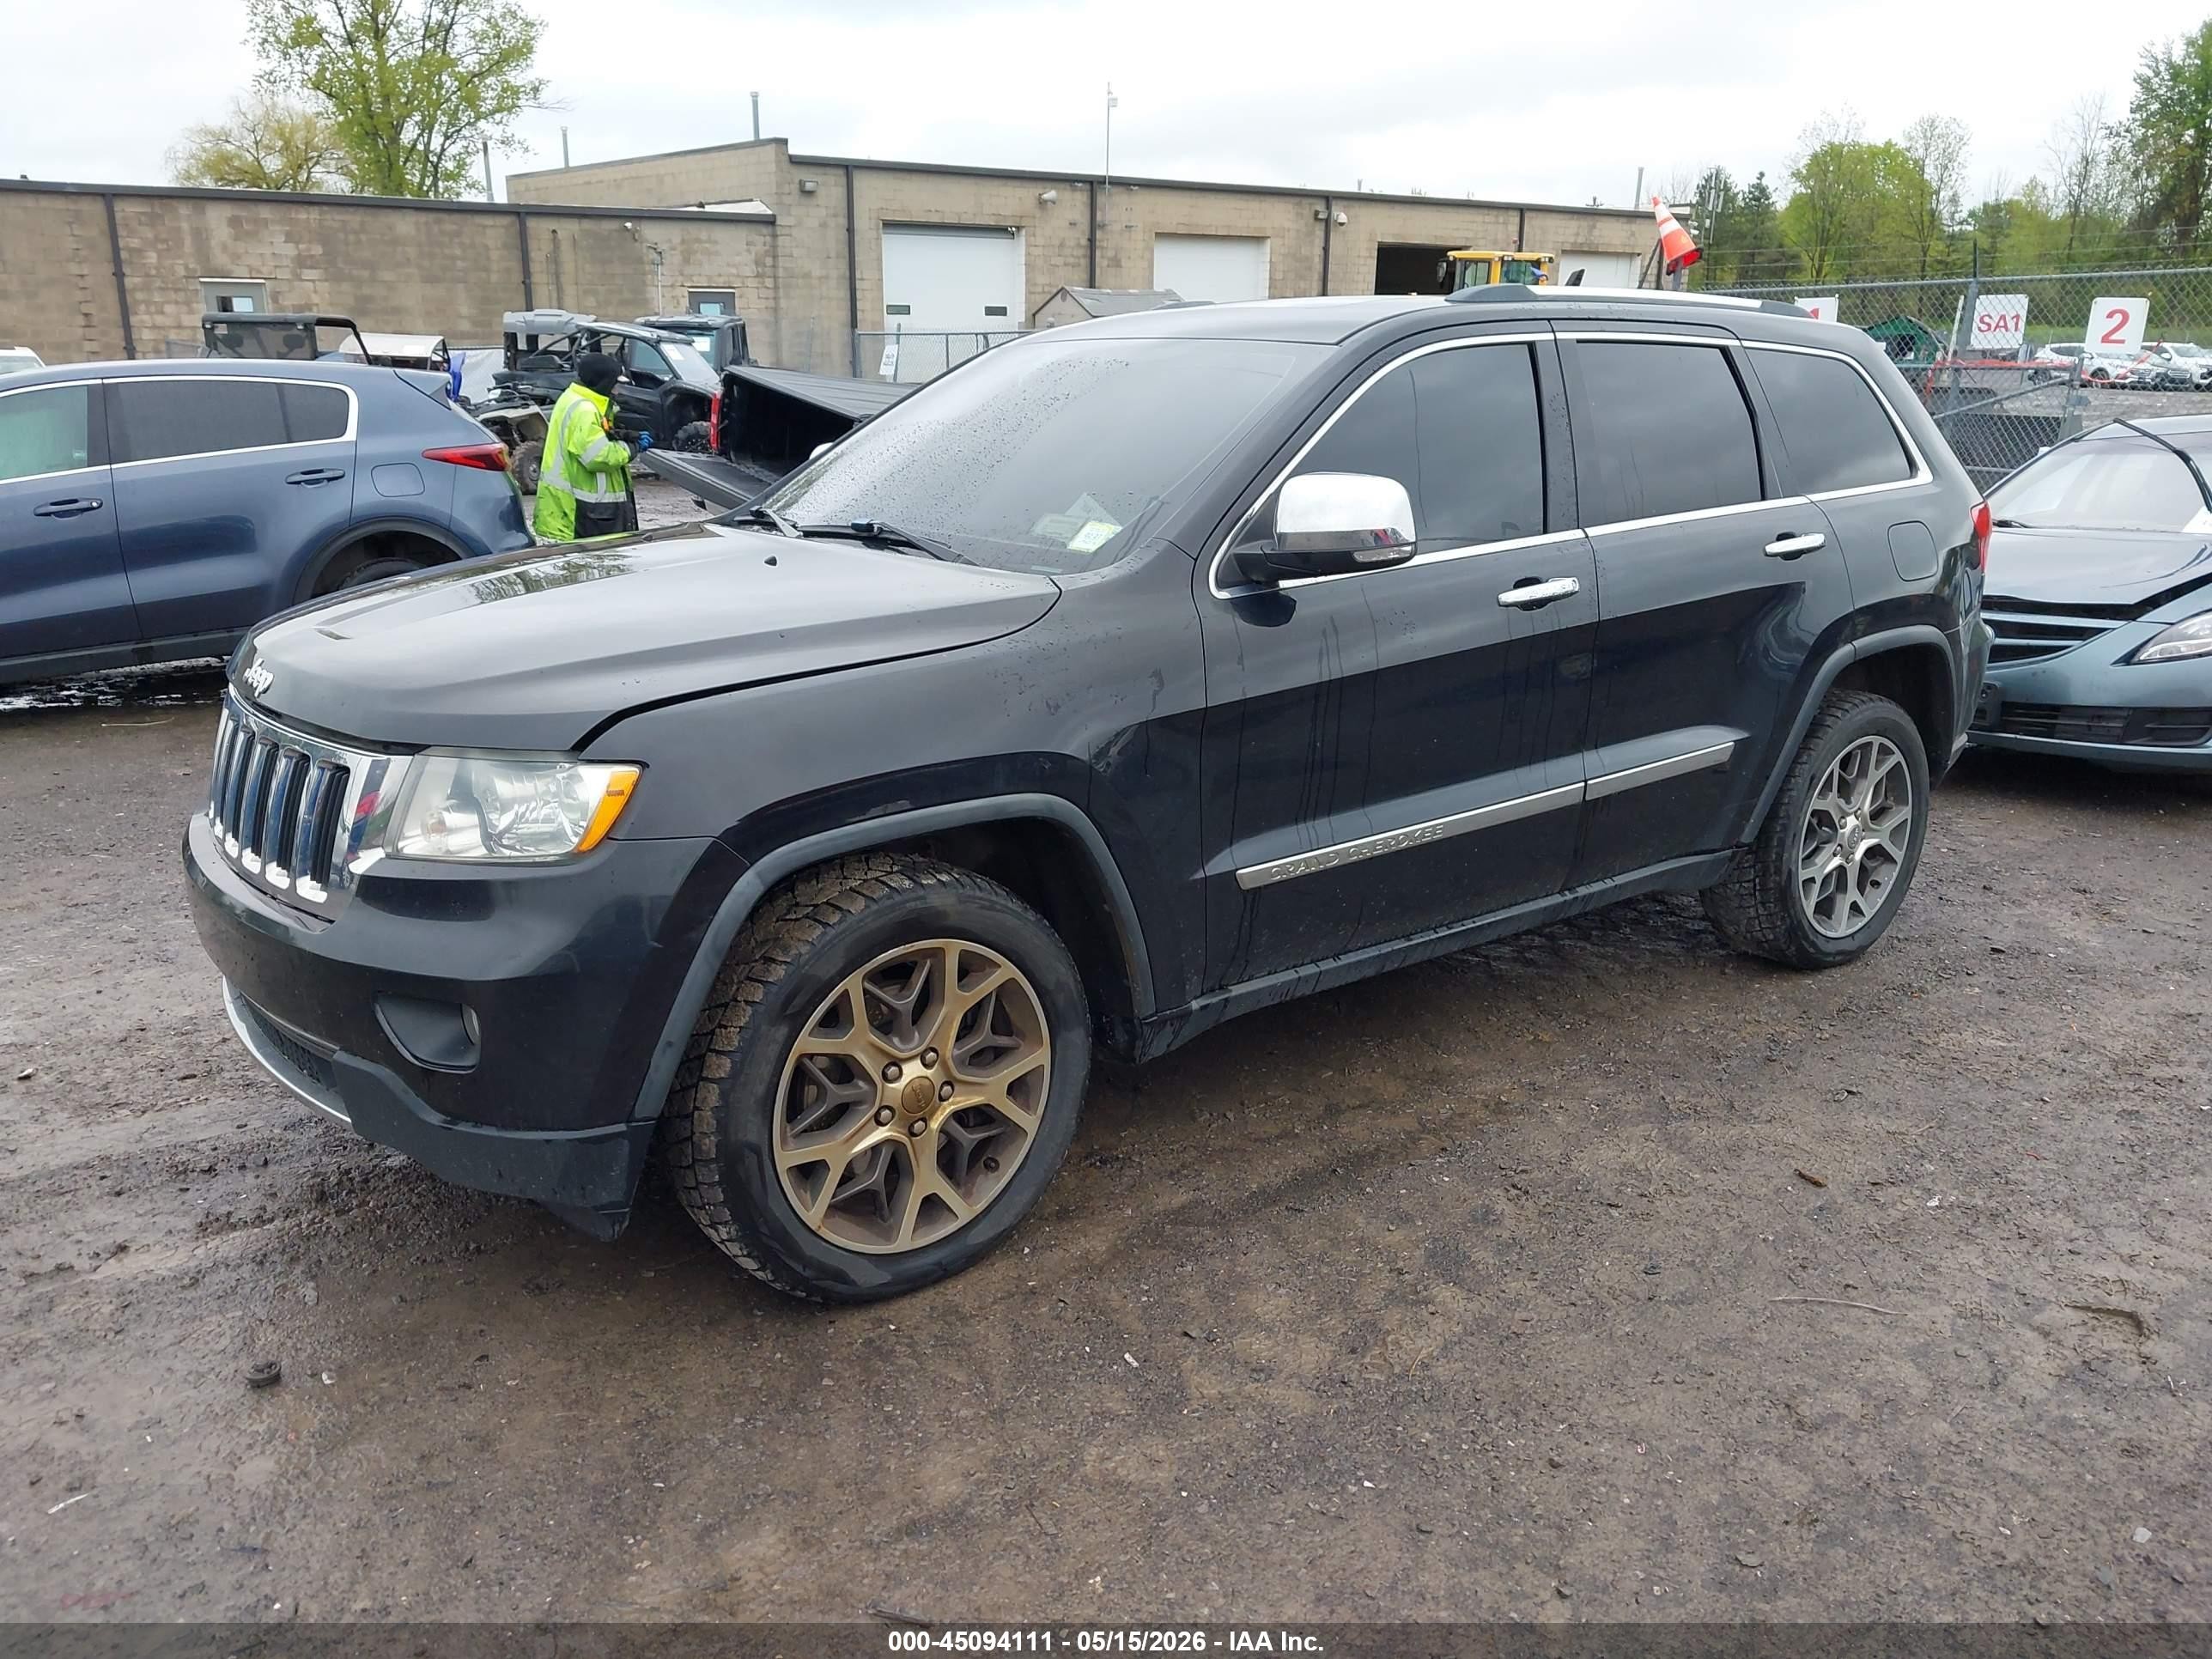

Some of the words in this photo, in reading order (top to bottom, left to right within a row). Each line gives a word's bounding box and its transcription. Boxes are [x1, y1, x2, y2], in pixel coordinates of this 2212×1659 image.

[1978, 313, 2021, 333] SA1
[2101, 308, 2130, 343] 2
[242, 658, 273, 697] Jeep
[1271, 853, 1340, 881] GRAND
[1348, 824, 1443, 860] CHEROKEE
